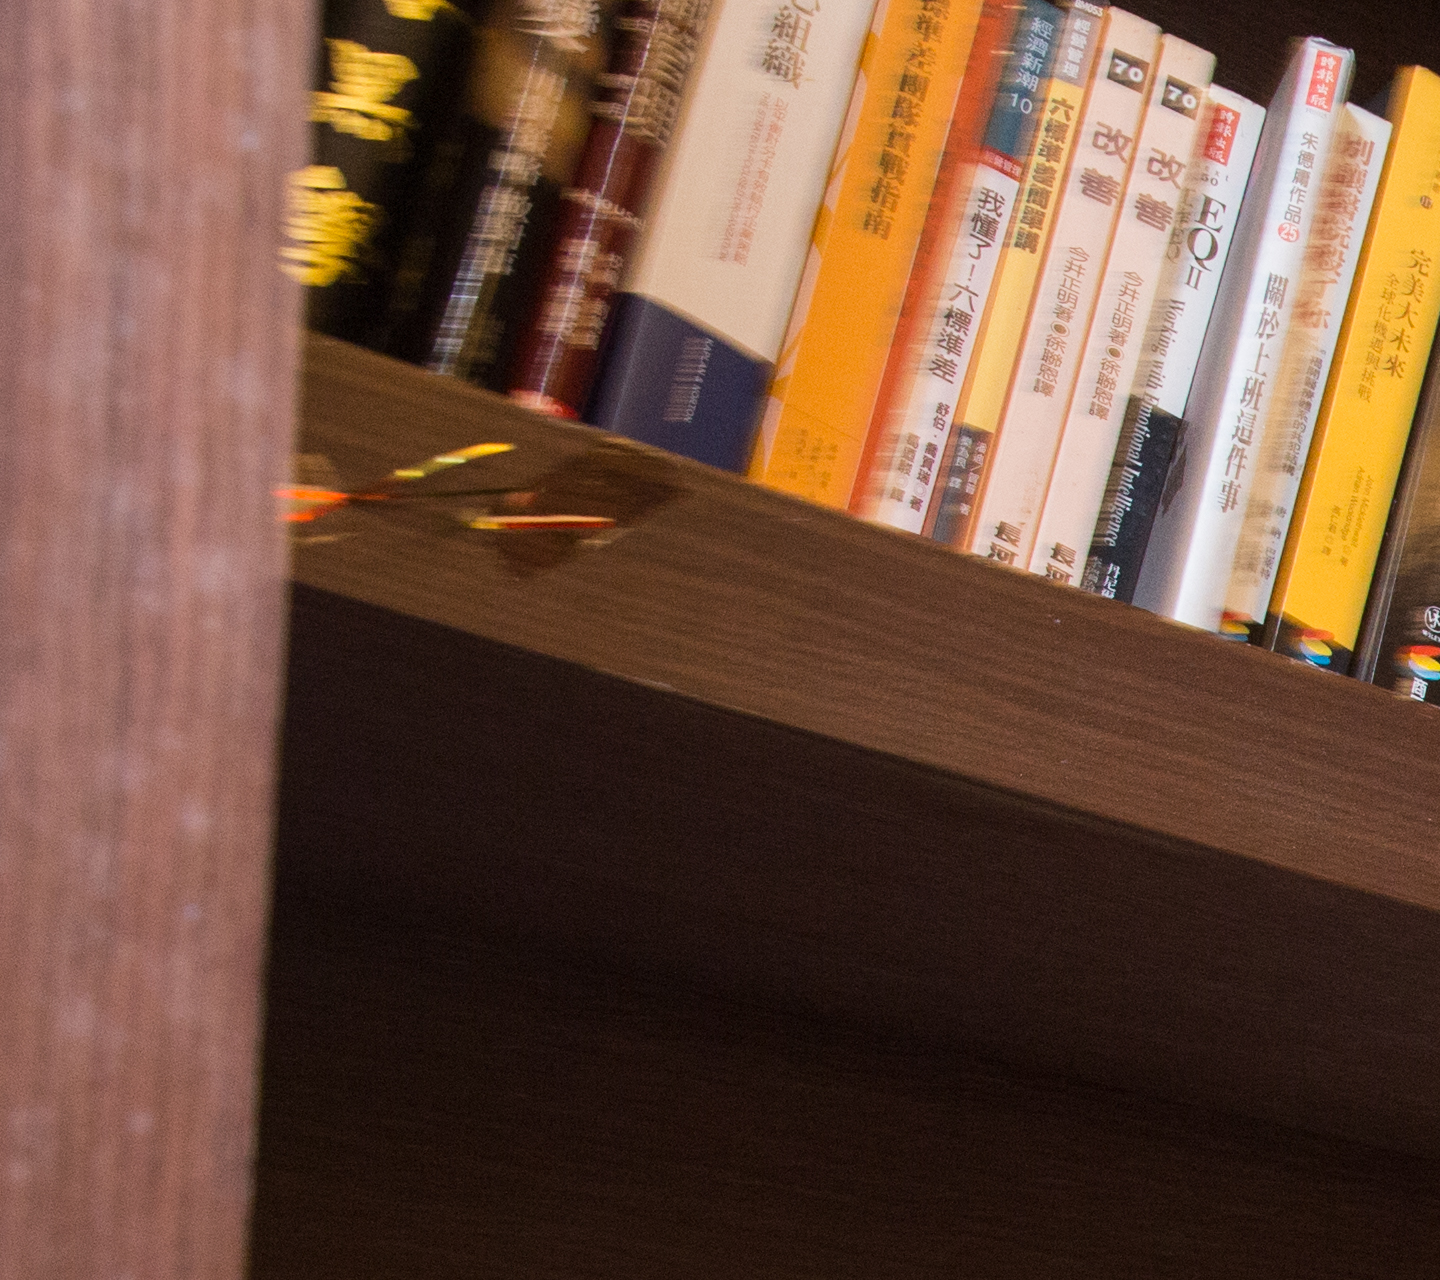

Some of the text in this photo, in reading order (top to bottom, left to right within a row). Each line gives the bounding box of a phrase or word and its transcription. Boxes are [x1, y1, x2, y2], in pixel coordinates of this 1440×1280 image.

[1016, 17, 1055, 92] 經濟新潮
[1113, 59, 1144, 83] 70
[1166, 84, 1199, 109] 70
[1309, 52, 1341, 110] 時報出版
[1009, 93, 1033, 115] 10
[1080, 121, 1134, 206] 改善
[1134, 147, 1186, 232] 改善
[1358, 272, 1400, 404] 全球化機遇與挑戰
[1383, 248, 1433, 380] 完美大未來
[1104, 297, 1183, 546] Working with Emotional Intelligence
[1220, 271, 1291, 513] 關於上班這件事
